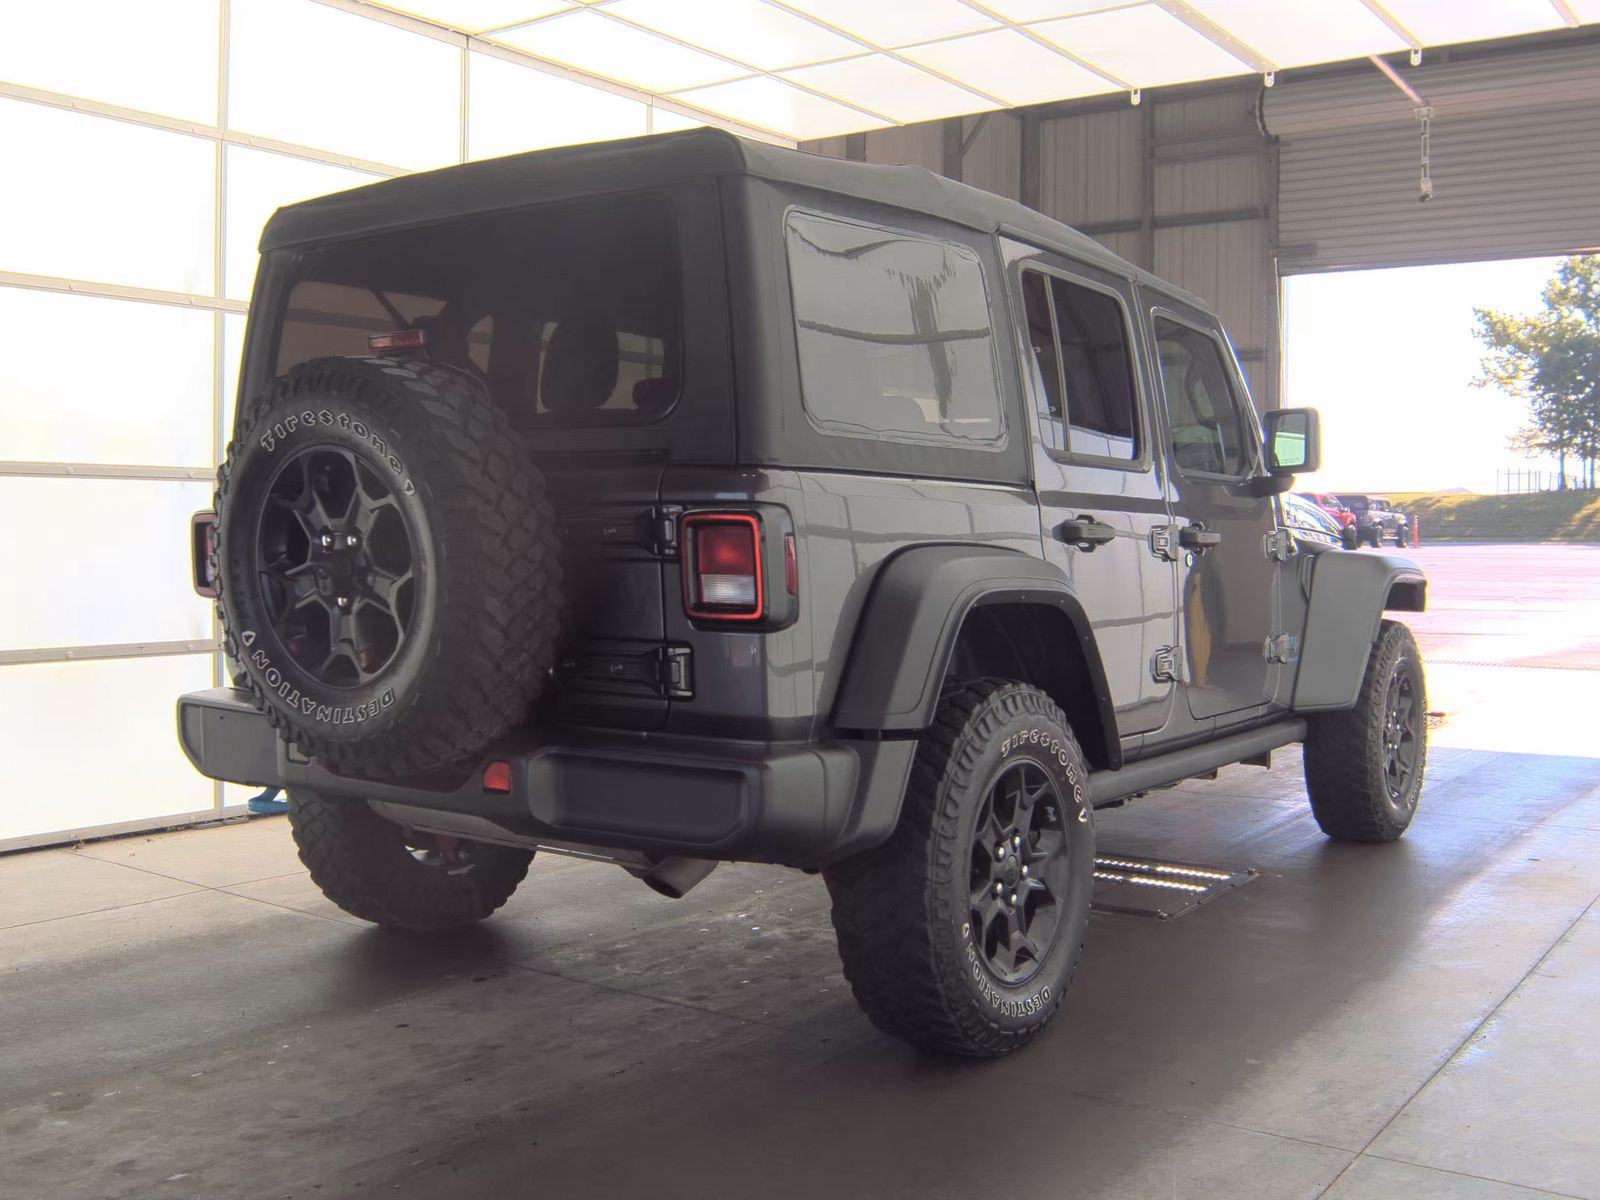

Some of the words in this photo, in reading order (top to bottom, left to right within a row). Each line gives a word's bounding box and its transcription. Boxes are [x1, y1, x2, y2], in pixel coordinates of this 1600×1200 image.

[260, 409, 403, 474] Firestone
[253, 650, 396, 724] DESTINATION
[1001, 729, 1082, 803] Firestone
[967, 941, 1051, 1017] DESTINATION
